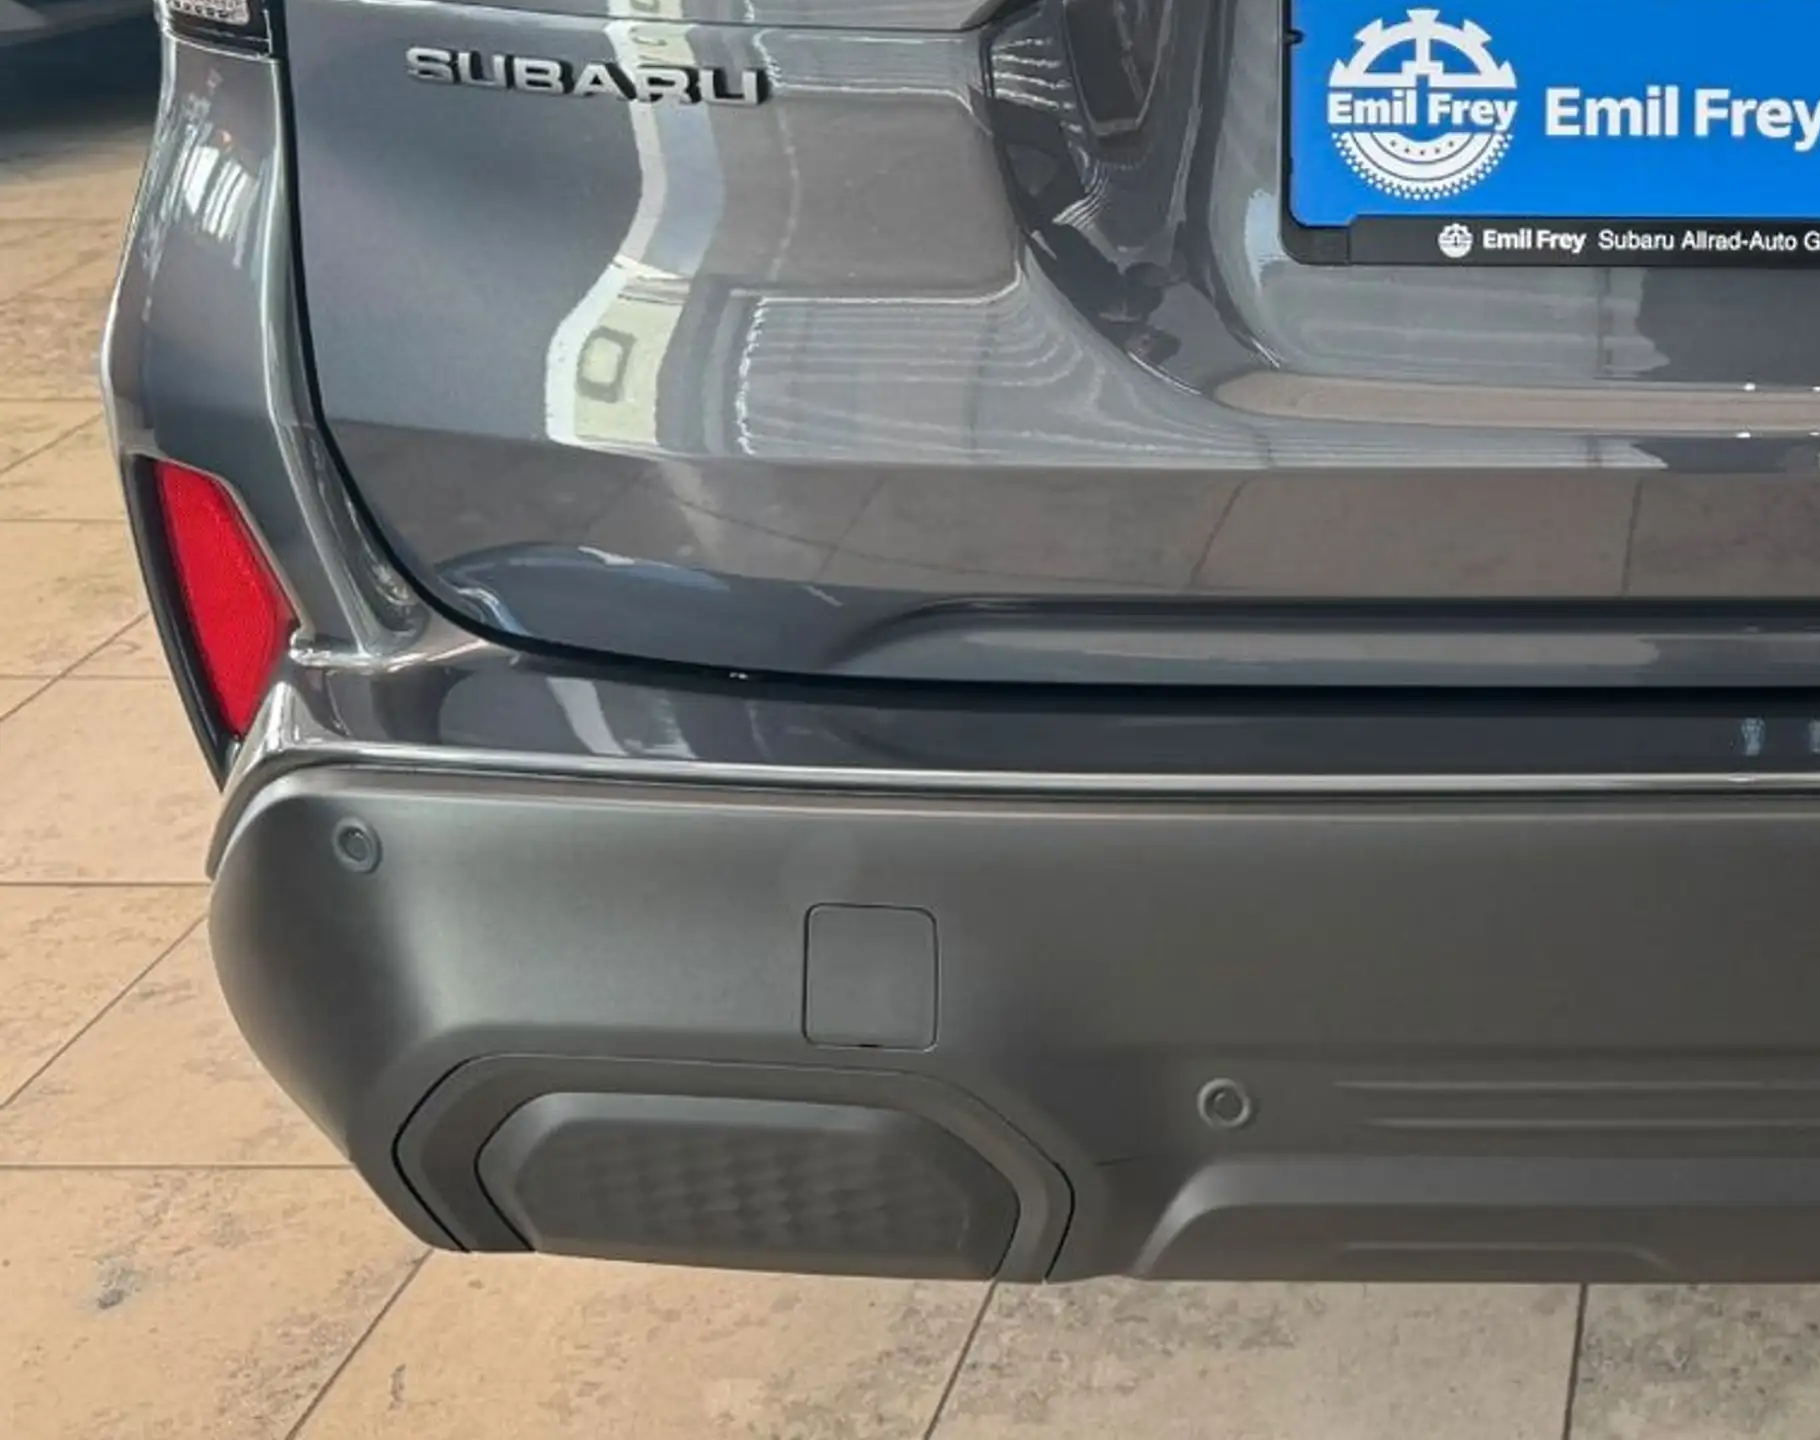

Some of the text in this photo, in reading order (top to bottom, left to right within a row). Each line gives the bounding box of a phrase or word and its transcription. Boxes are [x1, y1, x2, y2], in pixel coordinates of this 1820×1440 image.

[404, 46, 766, 106] SUBARU
[1328, 90, 1518, 132] Emil Frey
[1545, 85, 1679, 137] Emil
[1482, 228, 1532, 250] Emil
[1536, 229, 1587, 255] Frey
[1597, 229, 1675, 251] Subaru
[1680, 230, 1798, 252] Allrad-Auto
